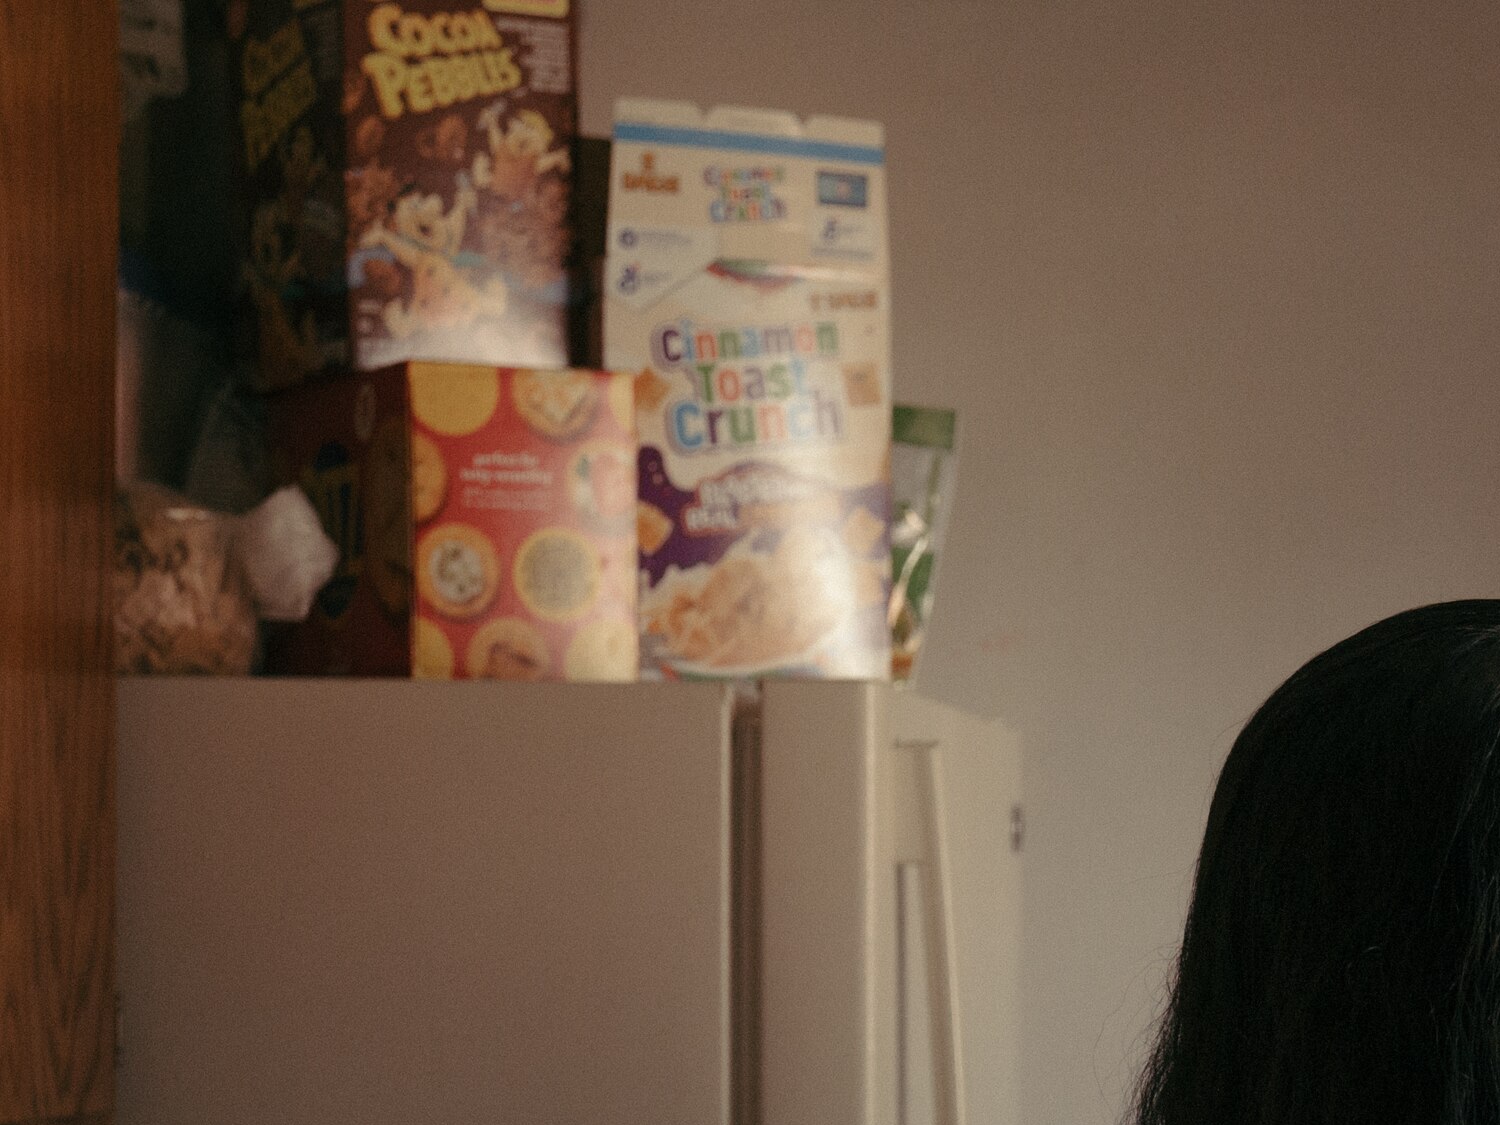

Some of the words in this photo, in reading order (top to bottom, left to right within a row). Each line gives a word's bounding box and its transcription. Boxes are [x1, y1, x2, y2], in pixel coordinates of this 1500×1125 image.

[367, 4, 502, 57] COCOA
[661, 319, 840, 363] Cinnamon
[696, 359, 809, 405] Toast
[673, 389, 844, 448] Crunch
